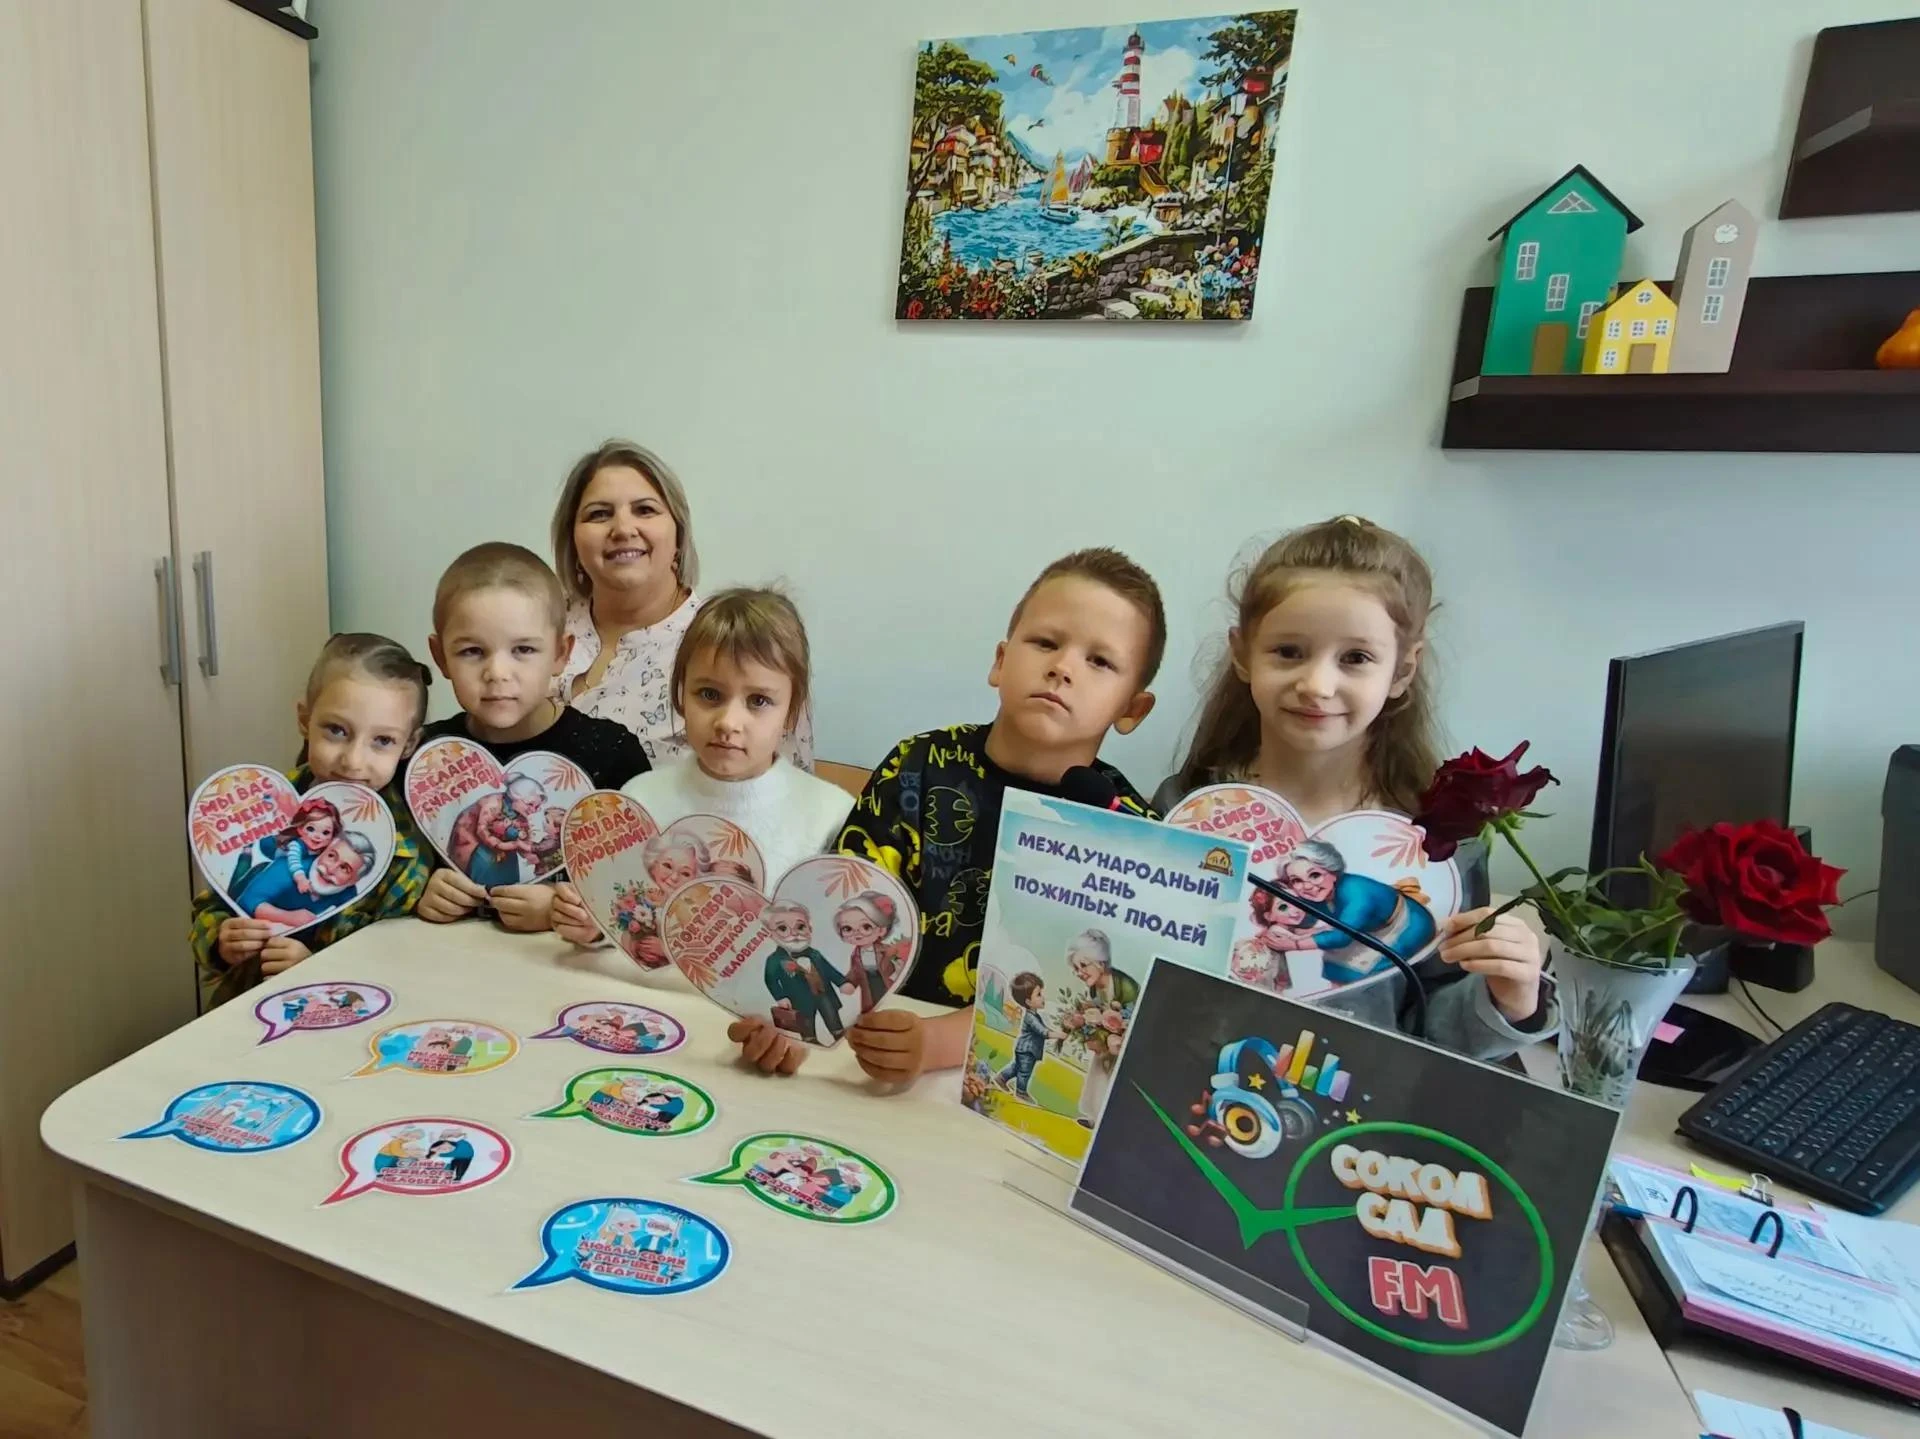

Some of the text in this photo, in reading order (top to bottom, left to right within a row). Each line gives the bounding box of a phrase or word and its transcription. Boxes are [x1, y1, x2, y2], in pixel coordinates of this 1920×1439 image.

[414, 752, 482, 793] ЖЕЛАЕМ
[422, 769, 493, 812] СЧАСТЬЯ!
[200, 777, 273, 817] МЫ ВАС
[216, 801, 274, 832] ОЧЕНЬ
[216, 815, 289, 856] ЦЕНИМ!
[571, 807, 636, 844] МЫ ВАС
[577, 828, 649, 866] ЛЮБИМ!
[1017, 832, 1221, 899] МЕЖДУНАРОДНЫЙ
[1082, 872, 1136, 900] ДЕНЬ
[1014, 874, 1208, 946] ПОЖИЛЫХ ЛЮДЕЙ
[703, 919, 727, 944] ДЕНЬ
[720, 927, 769, 977] ЧЕЛОВЕКА!
[1331, 1144, 1493, 1220] СОКОЛ
[580, 1241, 637, 1256] ЛЮБЛЮ
[1368, 1256, 1469, 1330] FM
